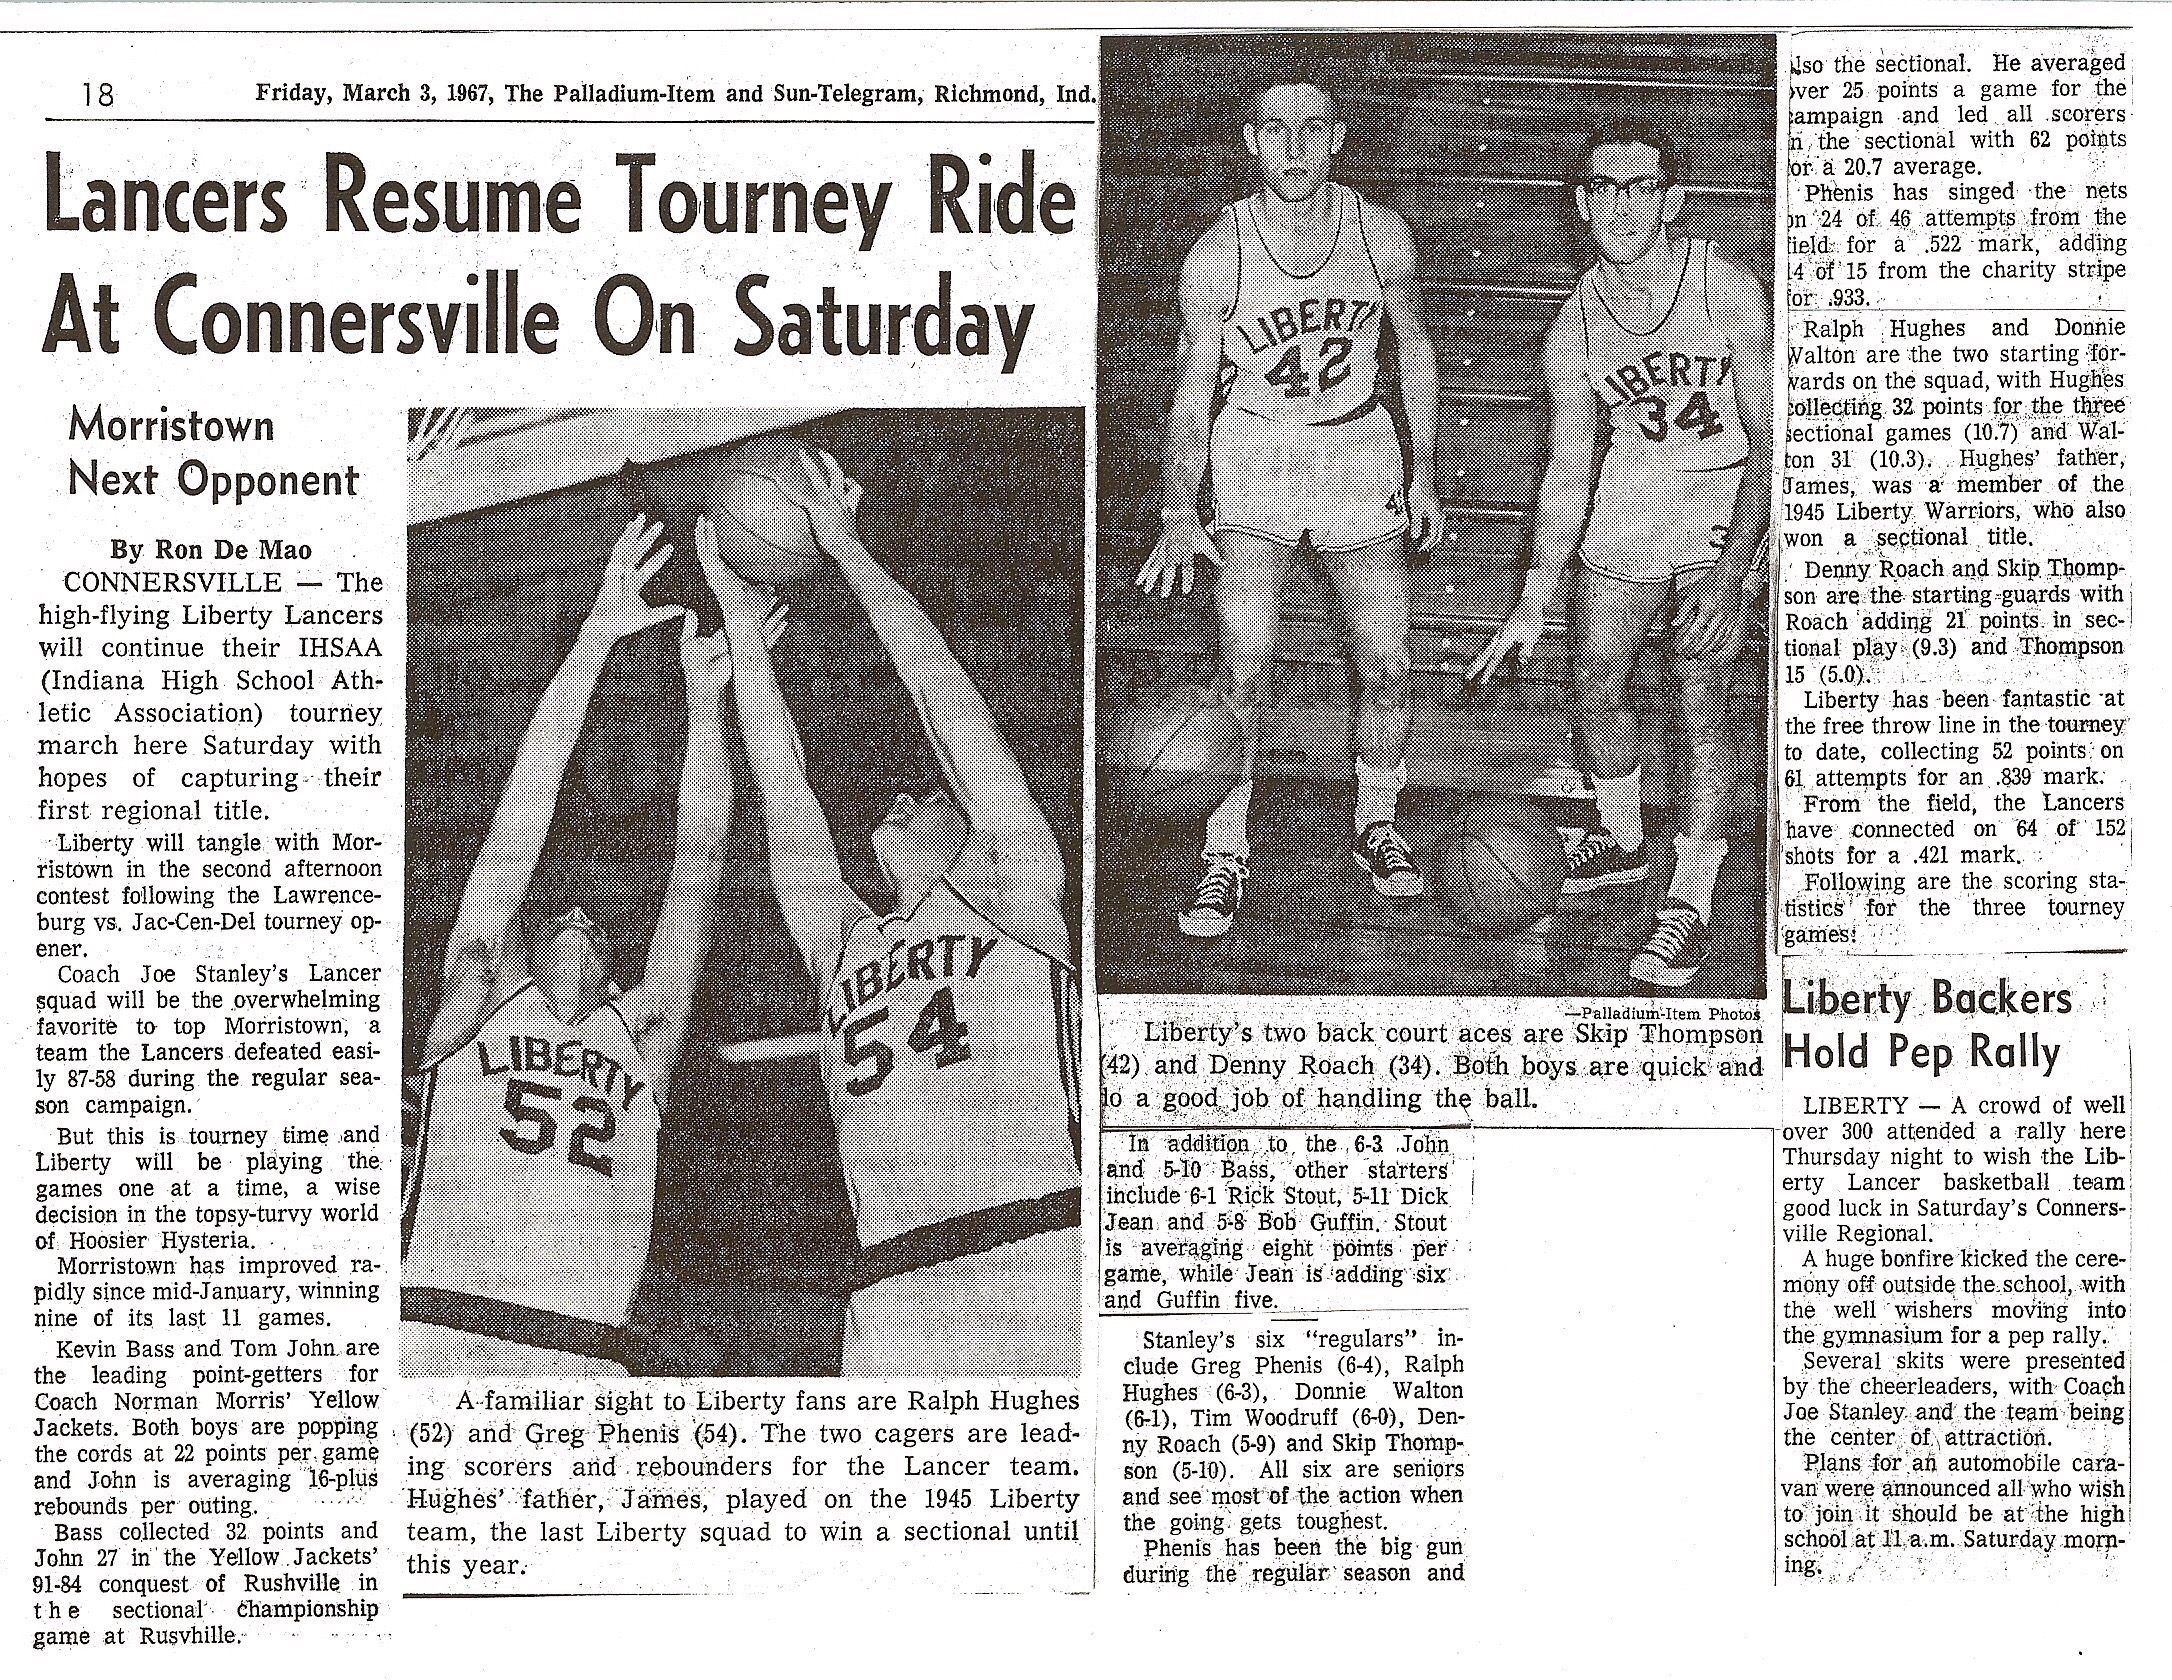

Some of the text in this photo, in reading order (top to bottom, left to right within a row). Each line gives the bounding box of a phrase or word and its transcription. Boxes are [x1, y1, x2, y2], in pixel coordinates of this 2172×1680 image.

[84, 83, 113, 107] 18
[256, 83, 1096, 106] Friday, March 3, 1967, The Palladium-Item and Sun-Telegram, Richmond, Ind.
[46, 149, 1076, 251] Lancers Resume Tourney Ride
[1805, 181, 2127, 204] Phenis has singed the nets
[42, 269, 1035, 374] At Connersville On Saturday
[1803, 318, 2125, 343] Ralph Hughes and Donnie
[1264, 336, 1354, 399] 42
[69, 404, 273, 442] Morristown
[1630, 390, 1724, 442] 34
[70, 458, 359, 505] Next Opponent
[1785, 500, 2125, 524] 1945 Liberty Warriors, who also
[111, 539, 312, 564] By Ron De Mao
[39, 603, 383, 630] high-flying Liberty Lancers
[39, 637, 382, 657] will continue their IHSAA
[42, 669, 383, 695] (Indiana High School Ath-
[39, 702, 382, 727] letic Association) tourney
[37, 734, 381, 760] march here Saturday with
[37, 912, 381, 935] burg vs. Jac-Cen-Del tourney op-
[828, 934, 998, 1038] LIBERTY
[37, 989, 380, 1013] squad will be the overwhelming
[1782, 978, 2072, 1023] Liberty Backers
[1709, 1008, 1761, 1021] Photos
[843, 984, 972, 1097] 54
[1264, 1023, 1305, 1042] two
[1317, 1022, 1374, 1042] back
[1386, 1024, 1447, 1043] court
[1459, 1028, 1511, 1044] aces
[1524, 1028, 1563, 1044] are
[1574, 1023, 1627, 1048] Skip
[1639, 1023, 1763, 1048] Thompson
[1785, 1032, 2060, 1077] Hold Pep Rally
[477, 1035, 646, 1111] LIBERTY
[500, 1078, 612, 1178] 52
[1107, 1186, 1448, 1207] include 6-1 Rick Stout, 5-11 Dick
[36, 1231, 256, 1254] of Hoosier Hysteria.
[1783, 1224, 1934, 1246] ville Regional.
[34, 1282, 379, 1305] pidly since mid-January, winning
[1124, 1354, 1464, 1378] clude Greg Phenis (6-4), Ralph
[1783, 1375, 2125, 1399] by the cheerleaders, with Coach
[35, 1392, 97, 1411] Coach
[115, 1393, 197, 1410] Norman
[309, 1390, 379, 1409] Yellow
[408, 1455, 1078, 1480] ing scorers and rebounders for the Lancer team.
[34, 1496, 258, 1518] rebounds per outing.
[407, 1519, 1079, 1547] team, the last Liberty squad to win a sectional until
[1124, 1512, 1387, 1535] the going gets toughest.
[407, 1554, 525, 1579] this year.
[33, 1573, 378, 1597] 91-84 conquest of Rushville in
